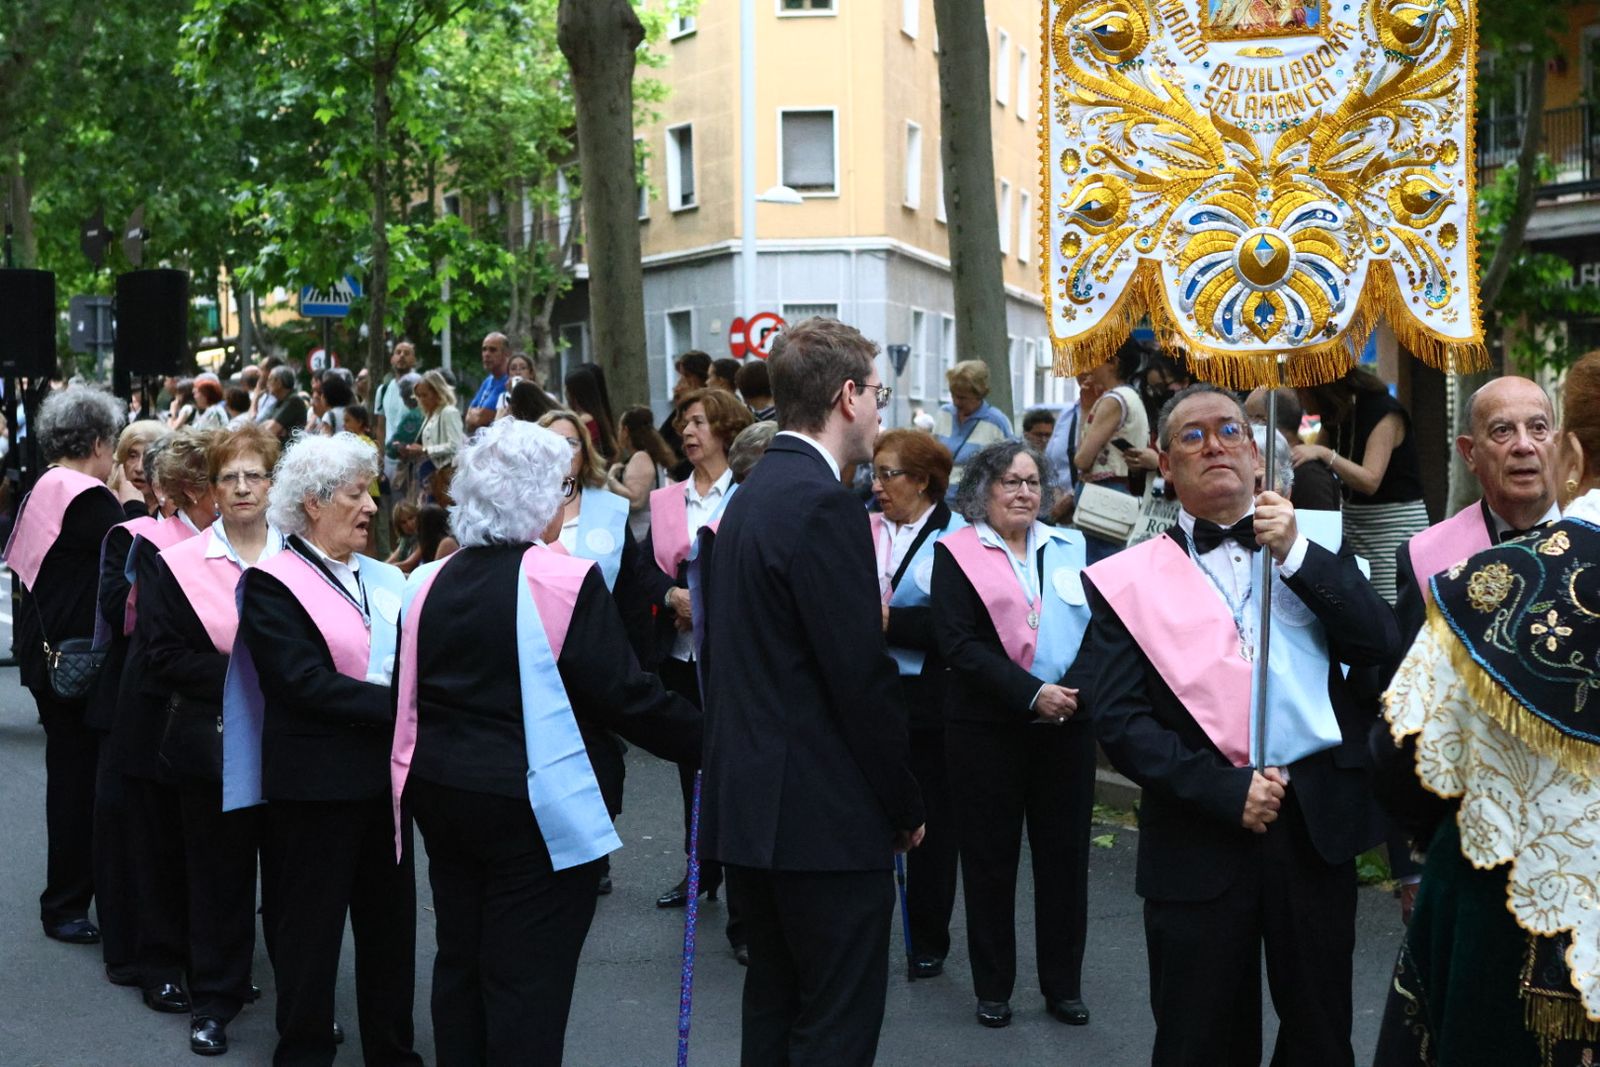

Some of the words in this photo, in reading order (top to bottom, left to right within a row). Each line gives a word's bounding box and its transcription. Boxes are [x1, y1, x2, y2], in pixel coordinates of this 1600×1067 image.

[1158, 0, 1209, 63] MARIA
[1209, 20, 1357, 92] AUXILIADORA
[1200, 76, 1337, 119] SALAMANCA
[1145, 518, 1173, 534] RO
